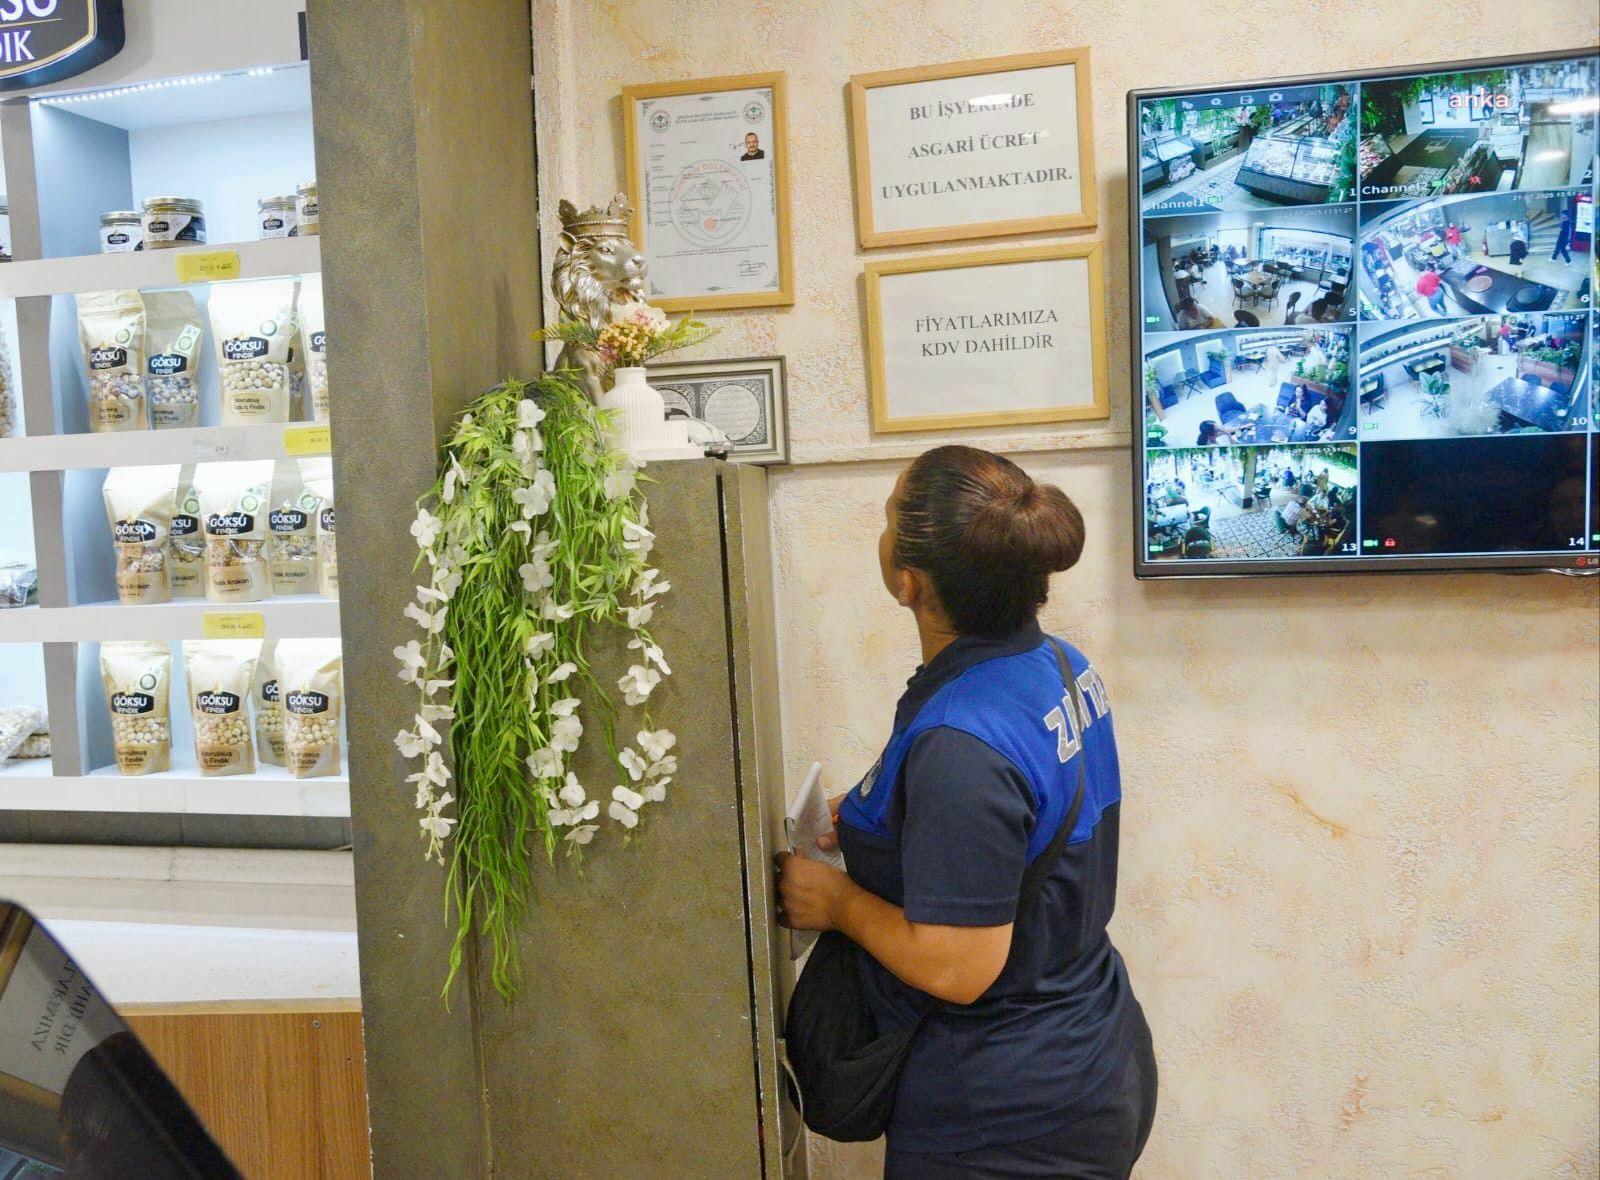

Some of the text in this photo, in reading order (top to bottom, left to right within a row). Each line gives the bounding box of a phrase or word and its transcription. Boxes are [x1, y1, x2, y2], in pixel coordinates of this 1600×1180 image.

[910, 105, 932, 120] BU
[908, 131, 1040, 158] ASGARİ ÜCRET
[882, 167, 1073, 200] UYGULANMAKTADIR.
[1151, 198, 1206, 210] hannel1
[1580, 293, 1590, 303] 6
[916, 308, 1059, 333] FİYATLARIMIZA
[226, 340, 261, 353] GÖKSU
[922, 332, 1054, 357] KDV DAHİLDİR
[151, 356, 182, 368] GÖKSU
[1571, 416, 1588, 426] 10
[1348, 426, 1358, 435] 9
[209, 516, 248, 528] GÖKSU
[271, 513, 301, 524] GÖKSU
[115, 524, 150, 535] GÖKSU
[1341, 542, 1357, 552] 13
[1568, 537, 1585, 546] 14
[113, 695, 148, 707] GÖKSU
[200, 694, 234, 707] GÖKSU
[288, 694, 322, 706] GÖKSU
